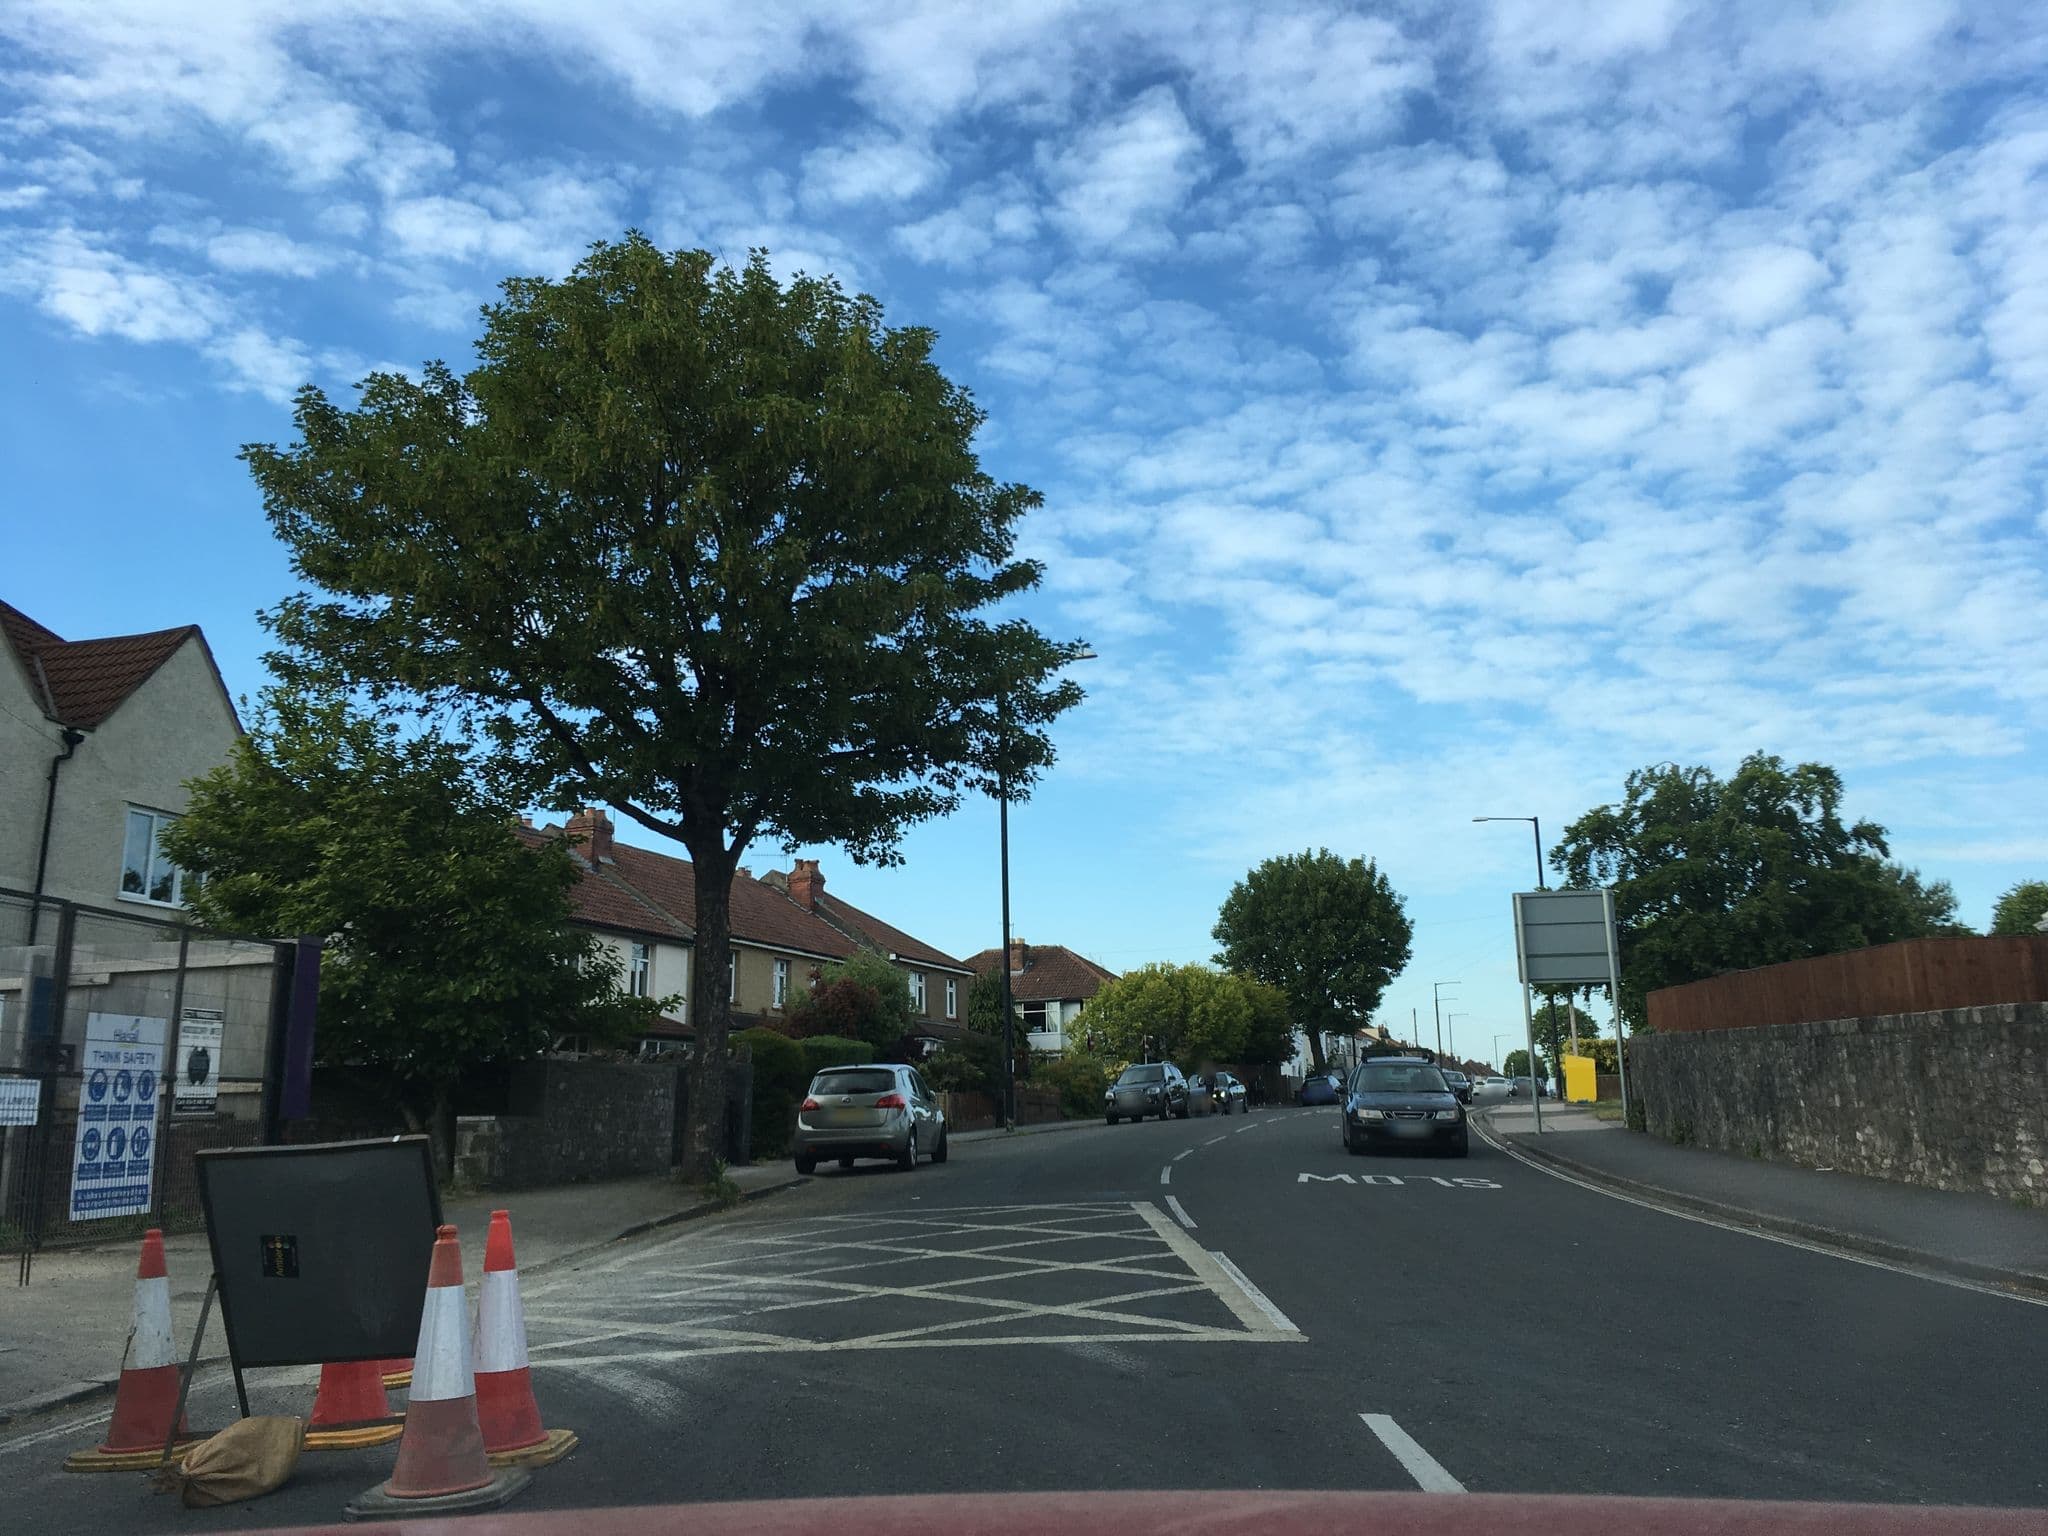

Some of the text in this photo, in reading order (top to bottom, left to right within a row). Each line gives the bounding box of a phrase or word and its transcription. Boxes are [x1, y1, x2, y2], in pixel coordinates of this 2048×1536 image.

[93, 1050, 157, 1066] THINK SAFETY
[1297, 1172, 1504, 1189] SLOW
